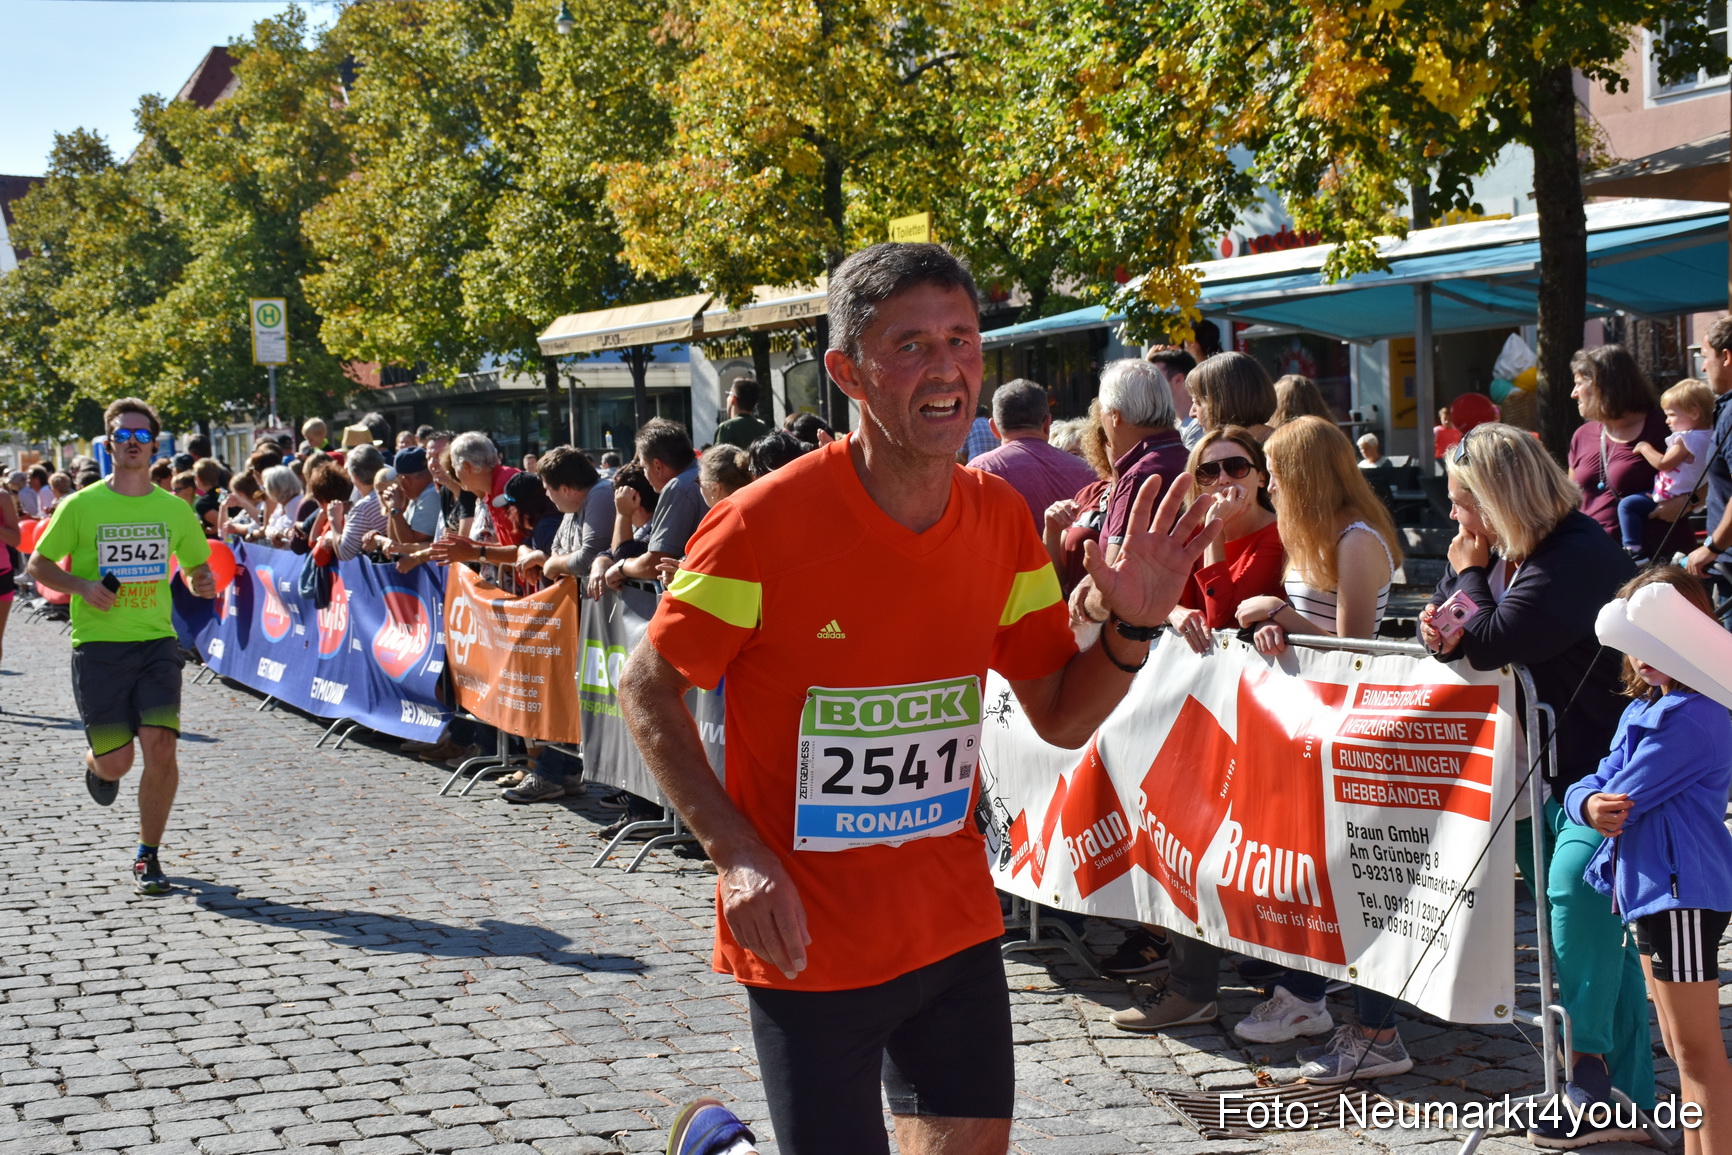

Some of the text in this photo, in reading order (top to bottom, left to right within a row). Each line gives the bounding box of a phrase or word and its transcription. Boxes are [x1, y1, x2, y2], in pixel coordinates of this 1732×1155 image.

[897, 225, 926, 239] Toiletten
[103, 526, 162, 540] BOCK
[107, 544, 159, 562] 2542
[106, 566, 161, 576] CHRISTIAN
[113, 598, 157, 608] EISEN
[119, 586, 157, 598] EMIUM
[817, 631, 846, 639] adidas
[816, 686, 967, 730] BOCK
[1361, 689, 1432, 707] BINDESTRICKE
[1346, 718, 1468, 741] VERZURRSYSTEME
[966, 738, 974, 747] D
[822, 738, 957, 795] 2541
[1339, 749, 1461, 775] RUNDSCHLINGEN
[1220, 783, 1231, 799] Seit
[1342, 782, 1441, 806] HEBEBÄNDER
[836, 803, 942, 833] RONALD
[1064, 810, 1128, 873] Braun
[1138, 786, 1193, 887] Braun
[1346, 822, 1430, 844] Braun GmbH
[1094, 853, 1115, 870] Sicher
[1115, 846, 1123, 857] ist
[1216, 819, 1322, 907] Braun
[1350, 843, 1439, 871] Am Grünberg 8
[1352, 863, 1404, 883] D-92318
[1357, 892, 1382, 909] Tel.
[1385, 895, 1414, 916] 09181
[1257, 904, 1340, 934] Sicher ist sicher
[1363, 912, 1385, 930] Fax
[1388, 916, 1413, 938] 09181
